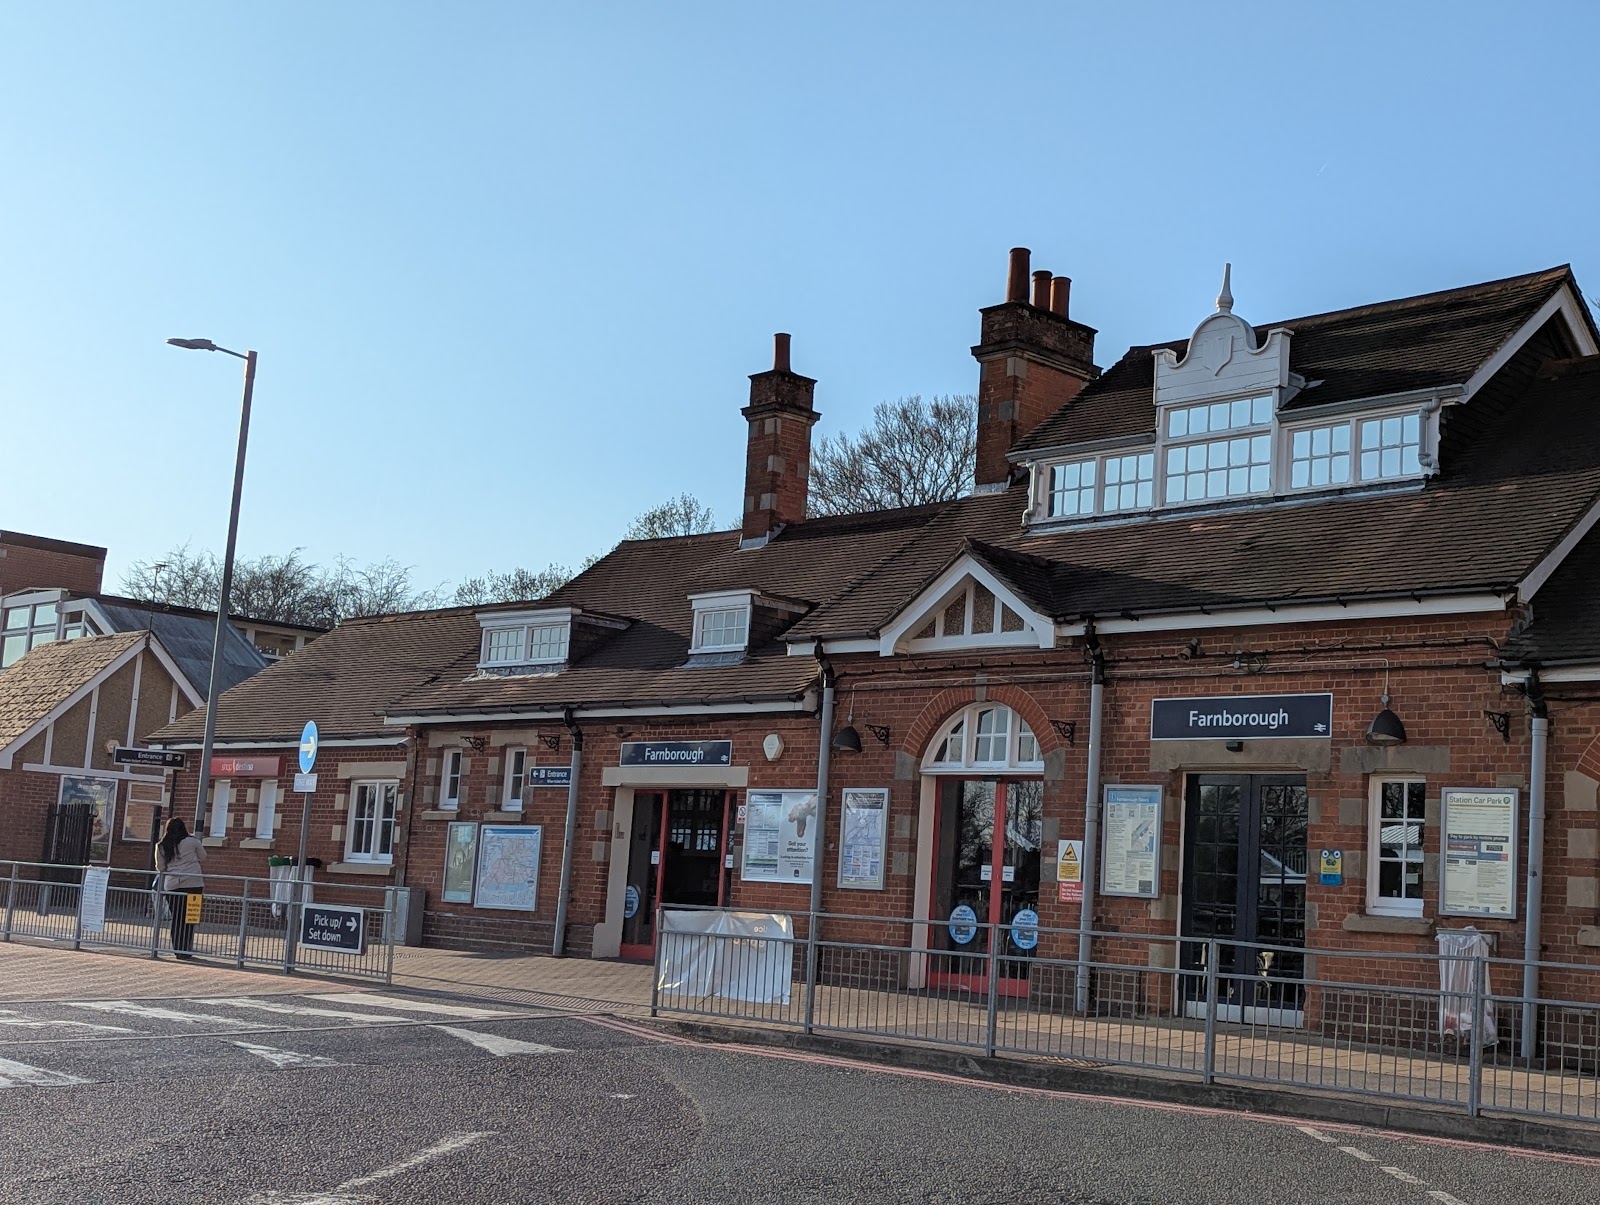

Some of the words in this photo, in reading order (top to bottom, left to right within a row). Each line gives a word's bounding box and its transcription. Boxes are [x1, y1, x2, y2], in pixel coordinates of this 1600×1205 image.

[1189, 708, 1289, 730] Farnborough
[137, 752, 163, 760] Entrance
[644, 747, 704, 763] Farnborough
[547, 769, 568, 778] Entrance
[1448, 795, 1473, 804] Station
[1473, 796, 1486, 804] Car
[1486, 797, 1503, 805] Park
[313, 913, 329, 927] Pick
[329, 915, 343, 930] up/
[308, 927, 321, 940] Set
[321, 929, 342, 943] down
